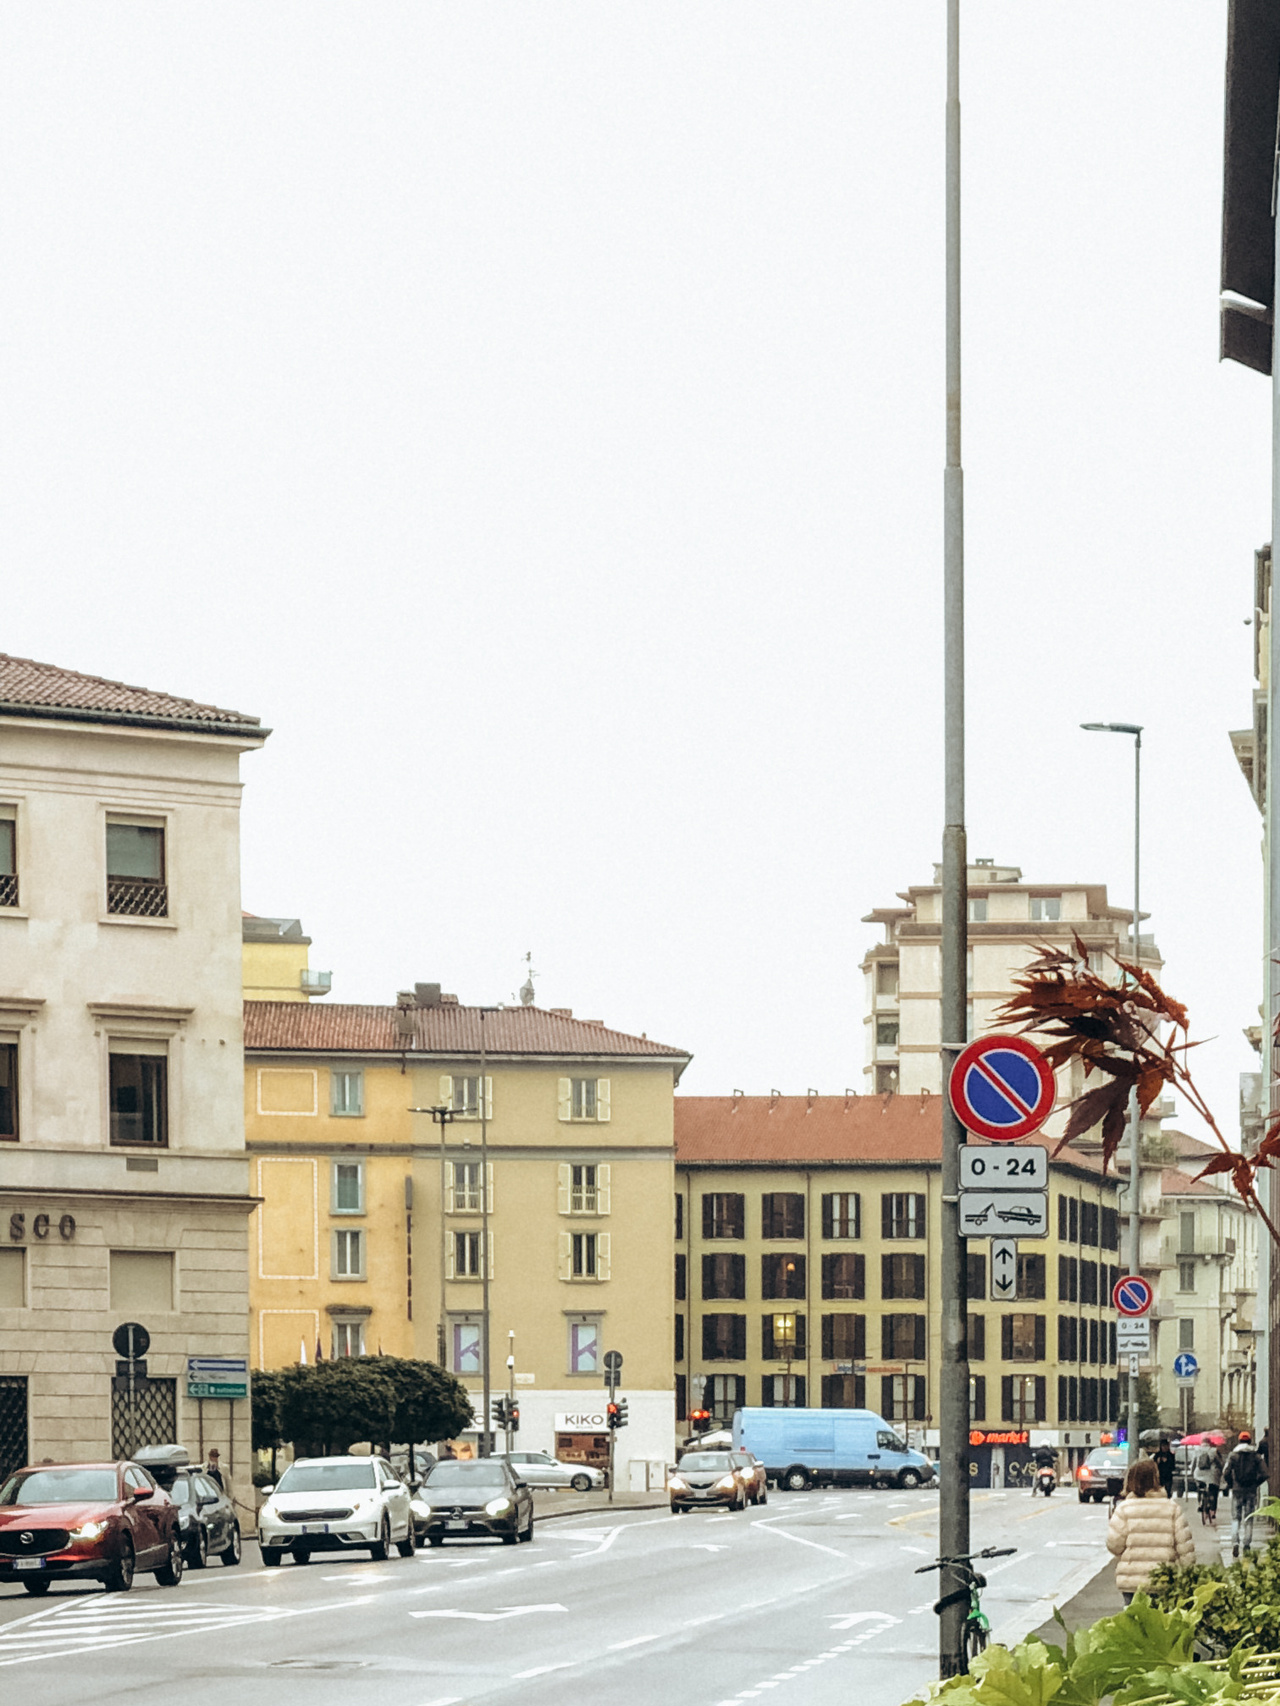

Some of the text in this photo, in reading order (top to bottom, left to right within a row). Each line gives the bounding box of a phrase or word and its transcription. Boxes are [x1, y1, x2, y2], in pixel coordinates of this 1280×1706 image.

[971, 1158, 986, 1176] 0
[1006, 1158, 1037, 1176] 24
[565, 1414, 604, 1425] KIKO
